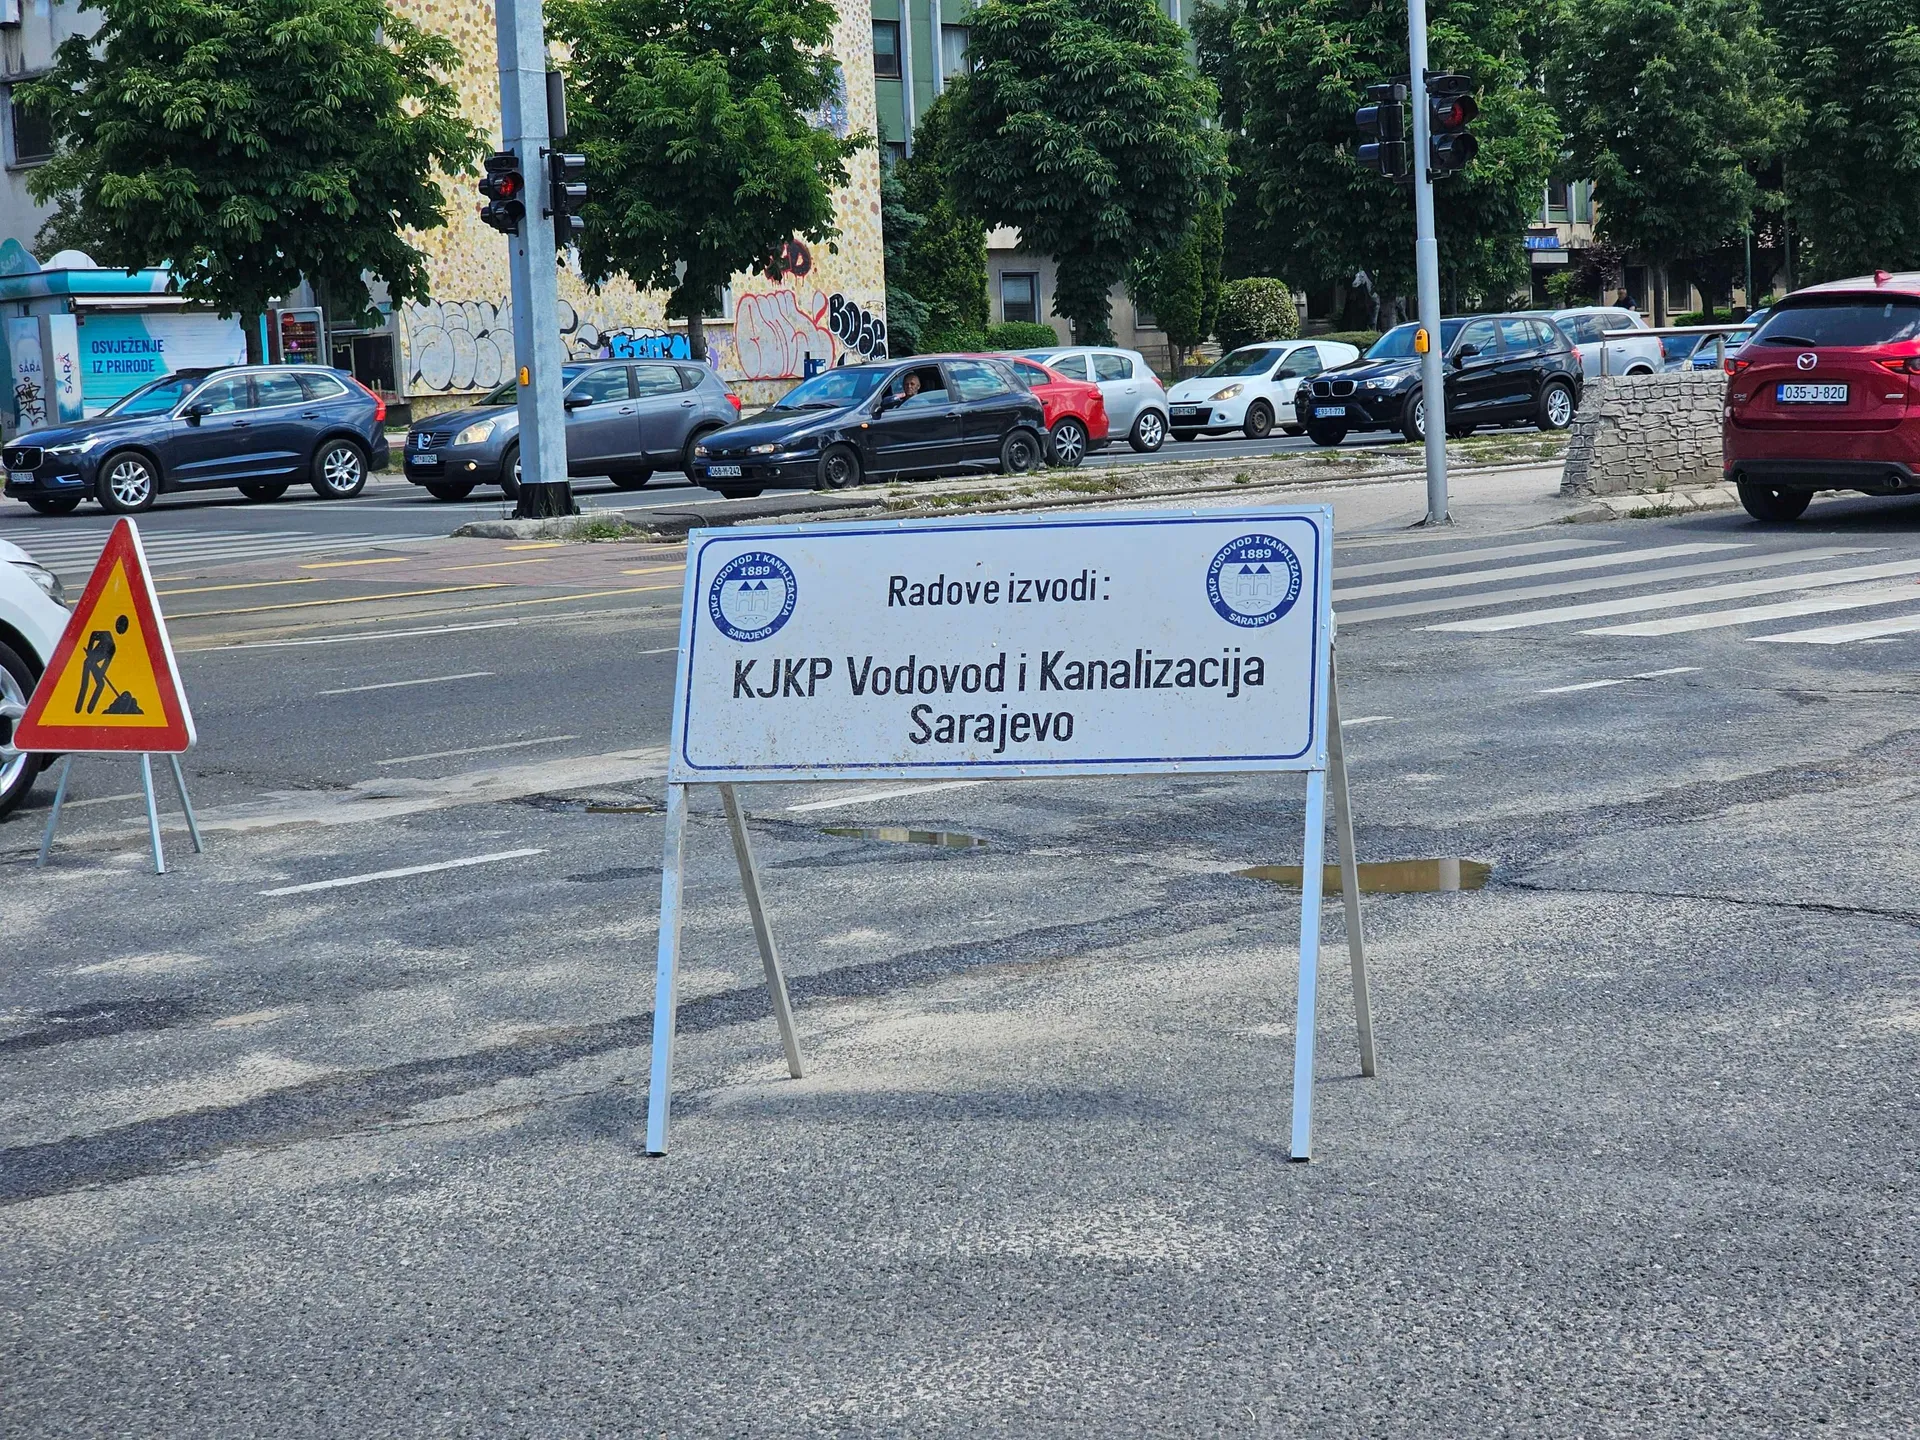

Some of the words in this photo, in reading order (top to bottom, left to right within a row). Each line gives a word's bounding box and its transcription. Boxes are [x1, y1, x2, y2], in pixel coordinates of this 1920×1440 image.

[92, 336, 164, 354] OSVJEŽENJE
[18, 363, 41, 373] SARA
[63, 353, 73, 394] SARA
[93, 360, 104, 373] IZ
[106, 359, 156, 373] PRIRODE
[1785, 386, 1845, 399] 035-J-820
[755, 553, 760, 561] I
[1210, 537, 1252, 574] VODOVOD
[1240, 549, 1272, 559] 1889
[713, 554, 752, 591] VODOVOD
[740, 566, 770, 576] 1889
[1263, 537, 1300, 601] KANALIZACIJA
[763, 554, 795, 616] KANALIZACIJA
[888, 574, 1000, 607] Radove
[1209, 578, 1221, 604] KJKP
[711, 594, 721, 619] KJKP
[1229, 612, 1277, 625] SARAJEVO
[727, 627, 772, 639] SARAJEVO
[733, 657, 833, 699] KJKP
[846, 653, 1006, 696] Vodovod
[1018, 653, 1027, 692] i
[1039, 648, 1265, 698] Kanalizacija
[908, 703, 1074, 754] Sarajevo
